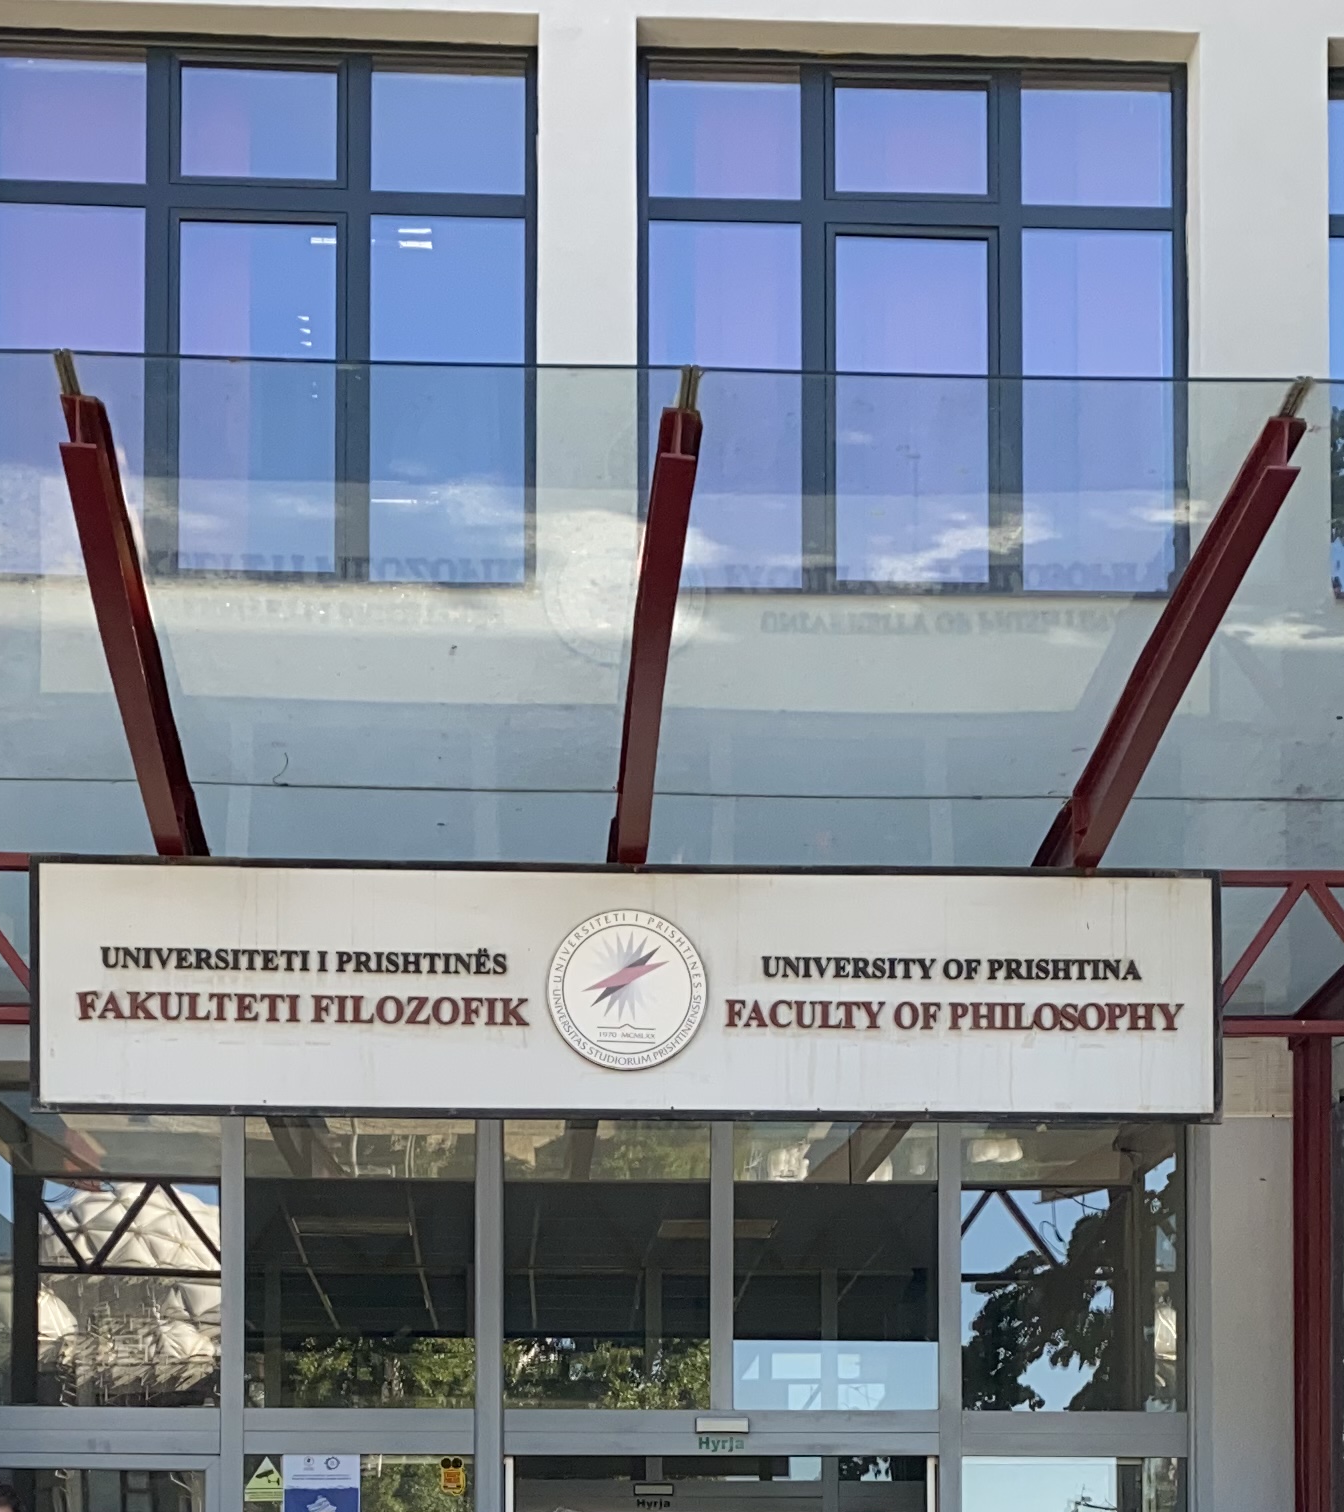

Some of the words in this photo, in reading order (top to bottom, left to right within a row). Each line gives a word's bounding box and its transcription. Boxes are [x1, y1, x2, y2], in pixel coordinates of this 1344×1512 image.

[100, 946, 310, 971] UNIVERSITETI
[317, 950, 328, 972] I
[335, 949, 508, 975] PRISHTINËS
[553, 912, 626, 984] UNIVERSITETI
[761, 956, 936, 980] UNIVERSITY
[943, 958, 981, 980] OF
[987, 958, 1142, 981] PRISHTINA
[76, 990, 301, 1022] FAKULTETI
[311, 995, 529, 1026] FILOZOFIK
[725, 999, 886, 1028] FACULTY
[894, 1001, 942, 1029] OF
[949, 1002, 1184, 1031] PHILOSOPHY
[552, 988, 587, 1051] UNIVERSITAS
[586, 1046, 653, 1066] STUDIORUM
[698, 1436, 745, 1452] Hyrja
[636, 1498, 671, 1510] Hyrja
